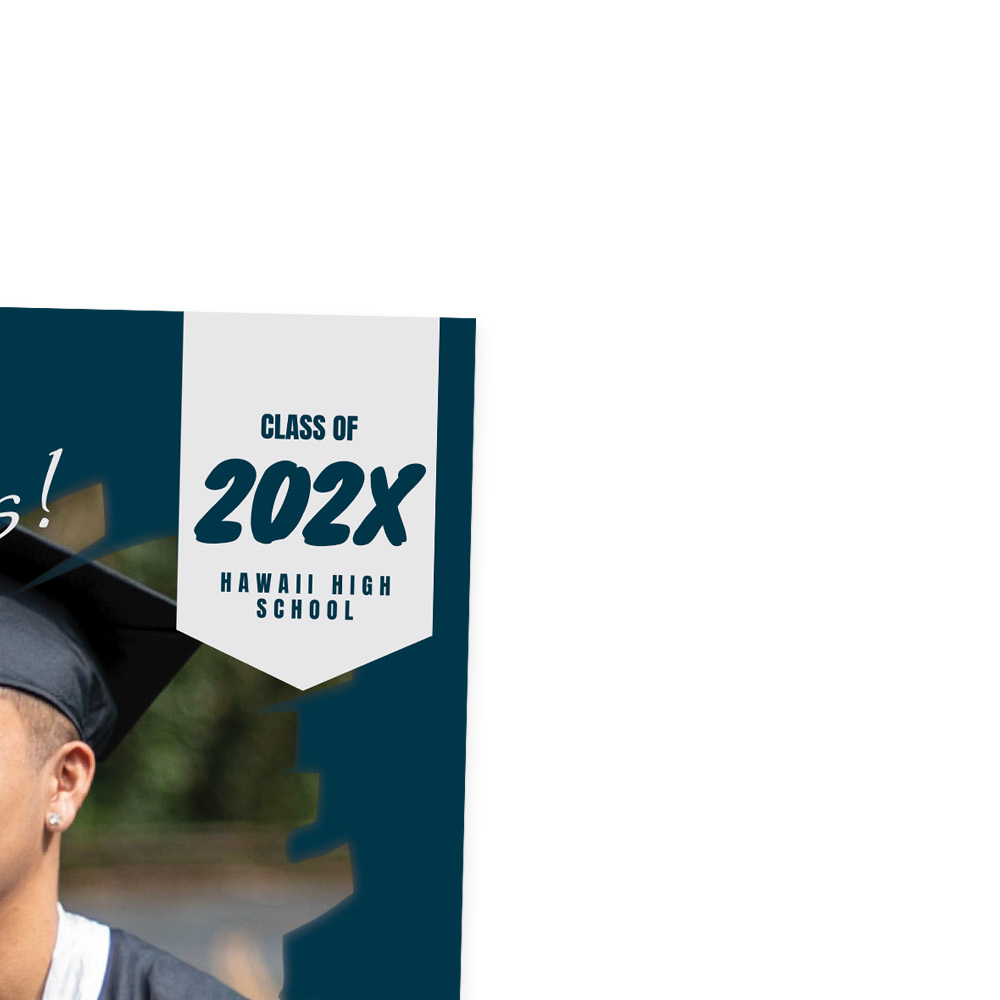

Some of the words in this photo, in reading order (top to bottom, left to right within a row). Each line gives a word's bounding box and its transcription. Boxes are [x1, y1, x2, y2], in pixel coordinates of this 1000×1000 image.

[261, 413, 326, 440] CLASS
[333, 415, 358, 441] OF
[194, 458, 426, 547] 202X
[220, 571, 314, 595] HAWAII
[332, 574, 391, 596] HIGH
[256, 598, 354, 621] SCHOOL
